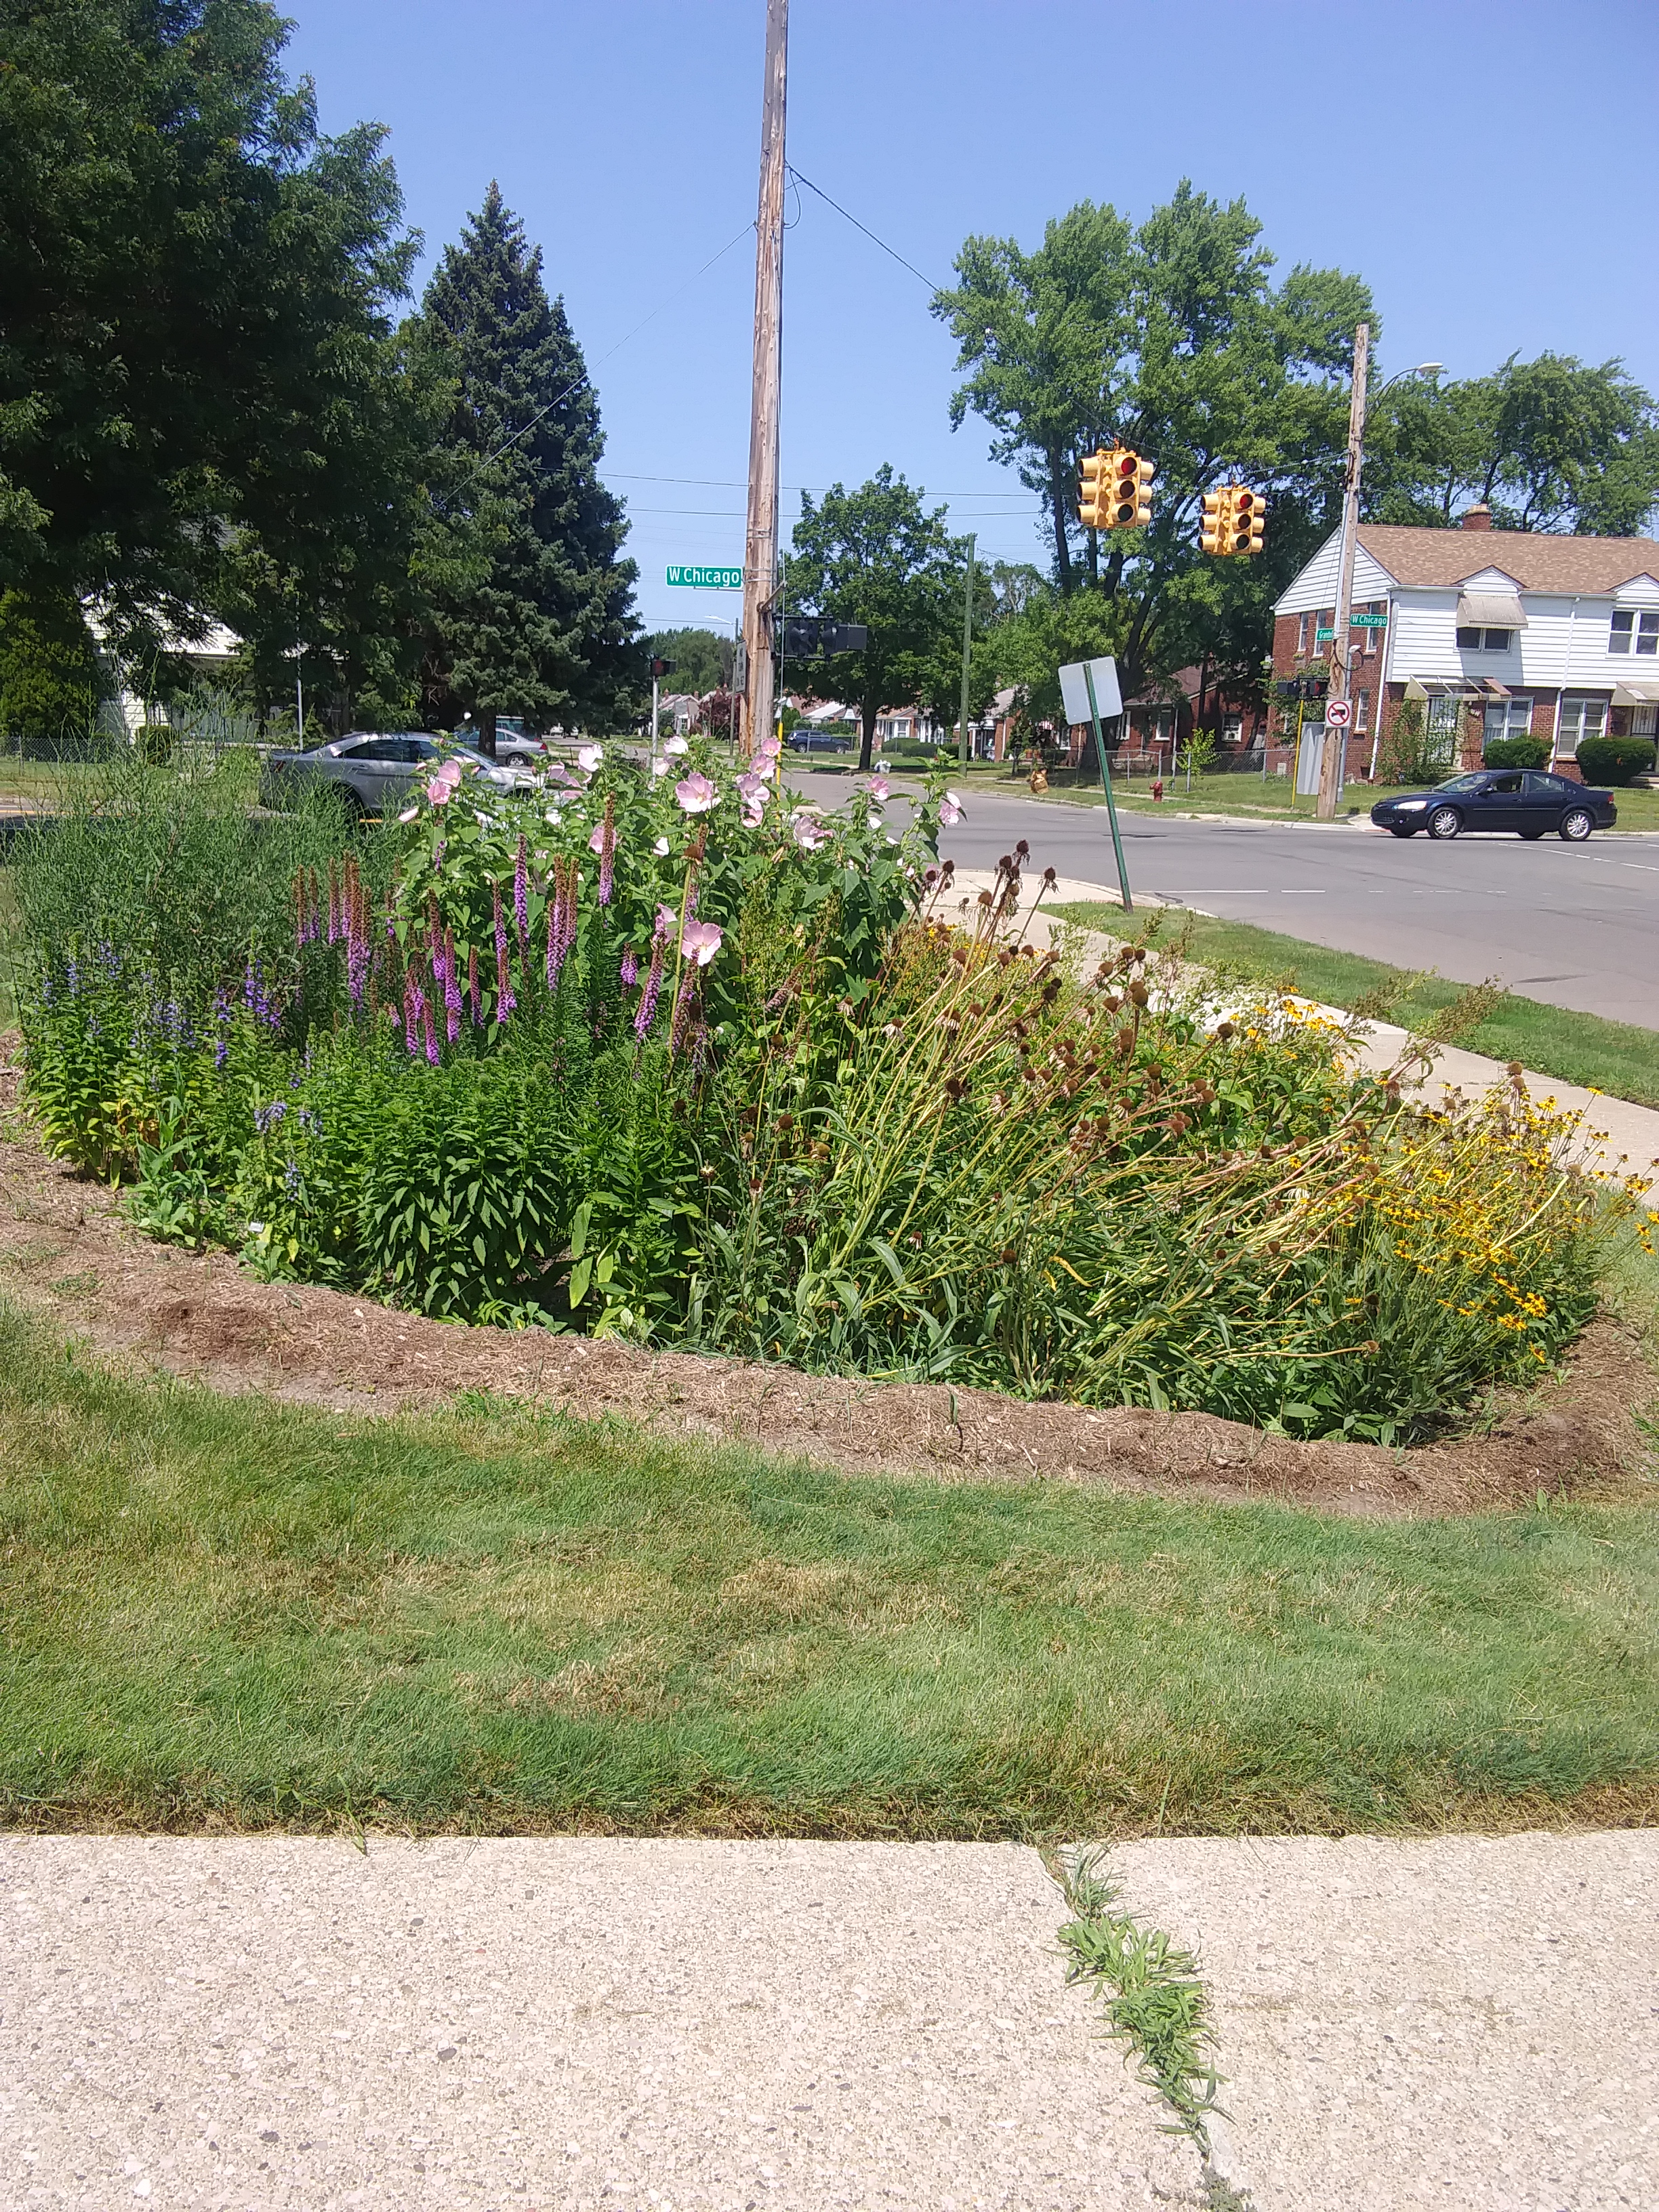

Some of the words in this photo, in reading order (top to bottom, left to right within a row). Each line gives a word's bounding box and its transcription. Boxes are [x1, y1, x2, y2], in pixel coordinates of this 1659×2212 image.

[669, 567, 680, 582] W
[684, 568, 739, 587] Chicago
[1352, 615, 1359, 623] W
[1359, 615, 1387, 626] Chicago
